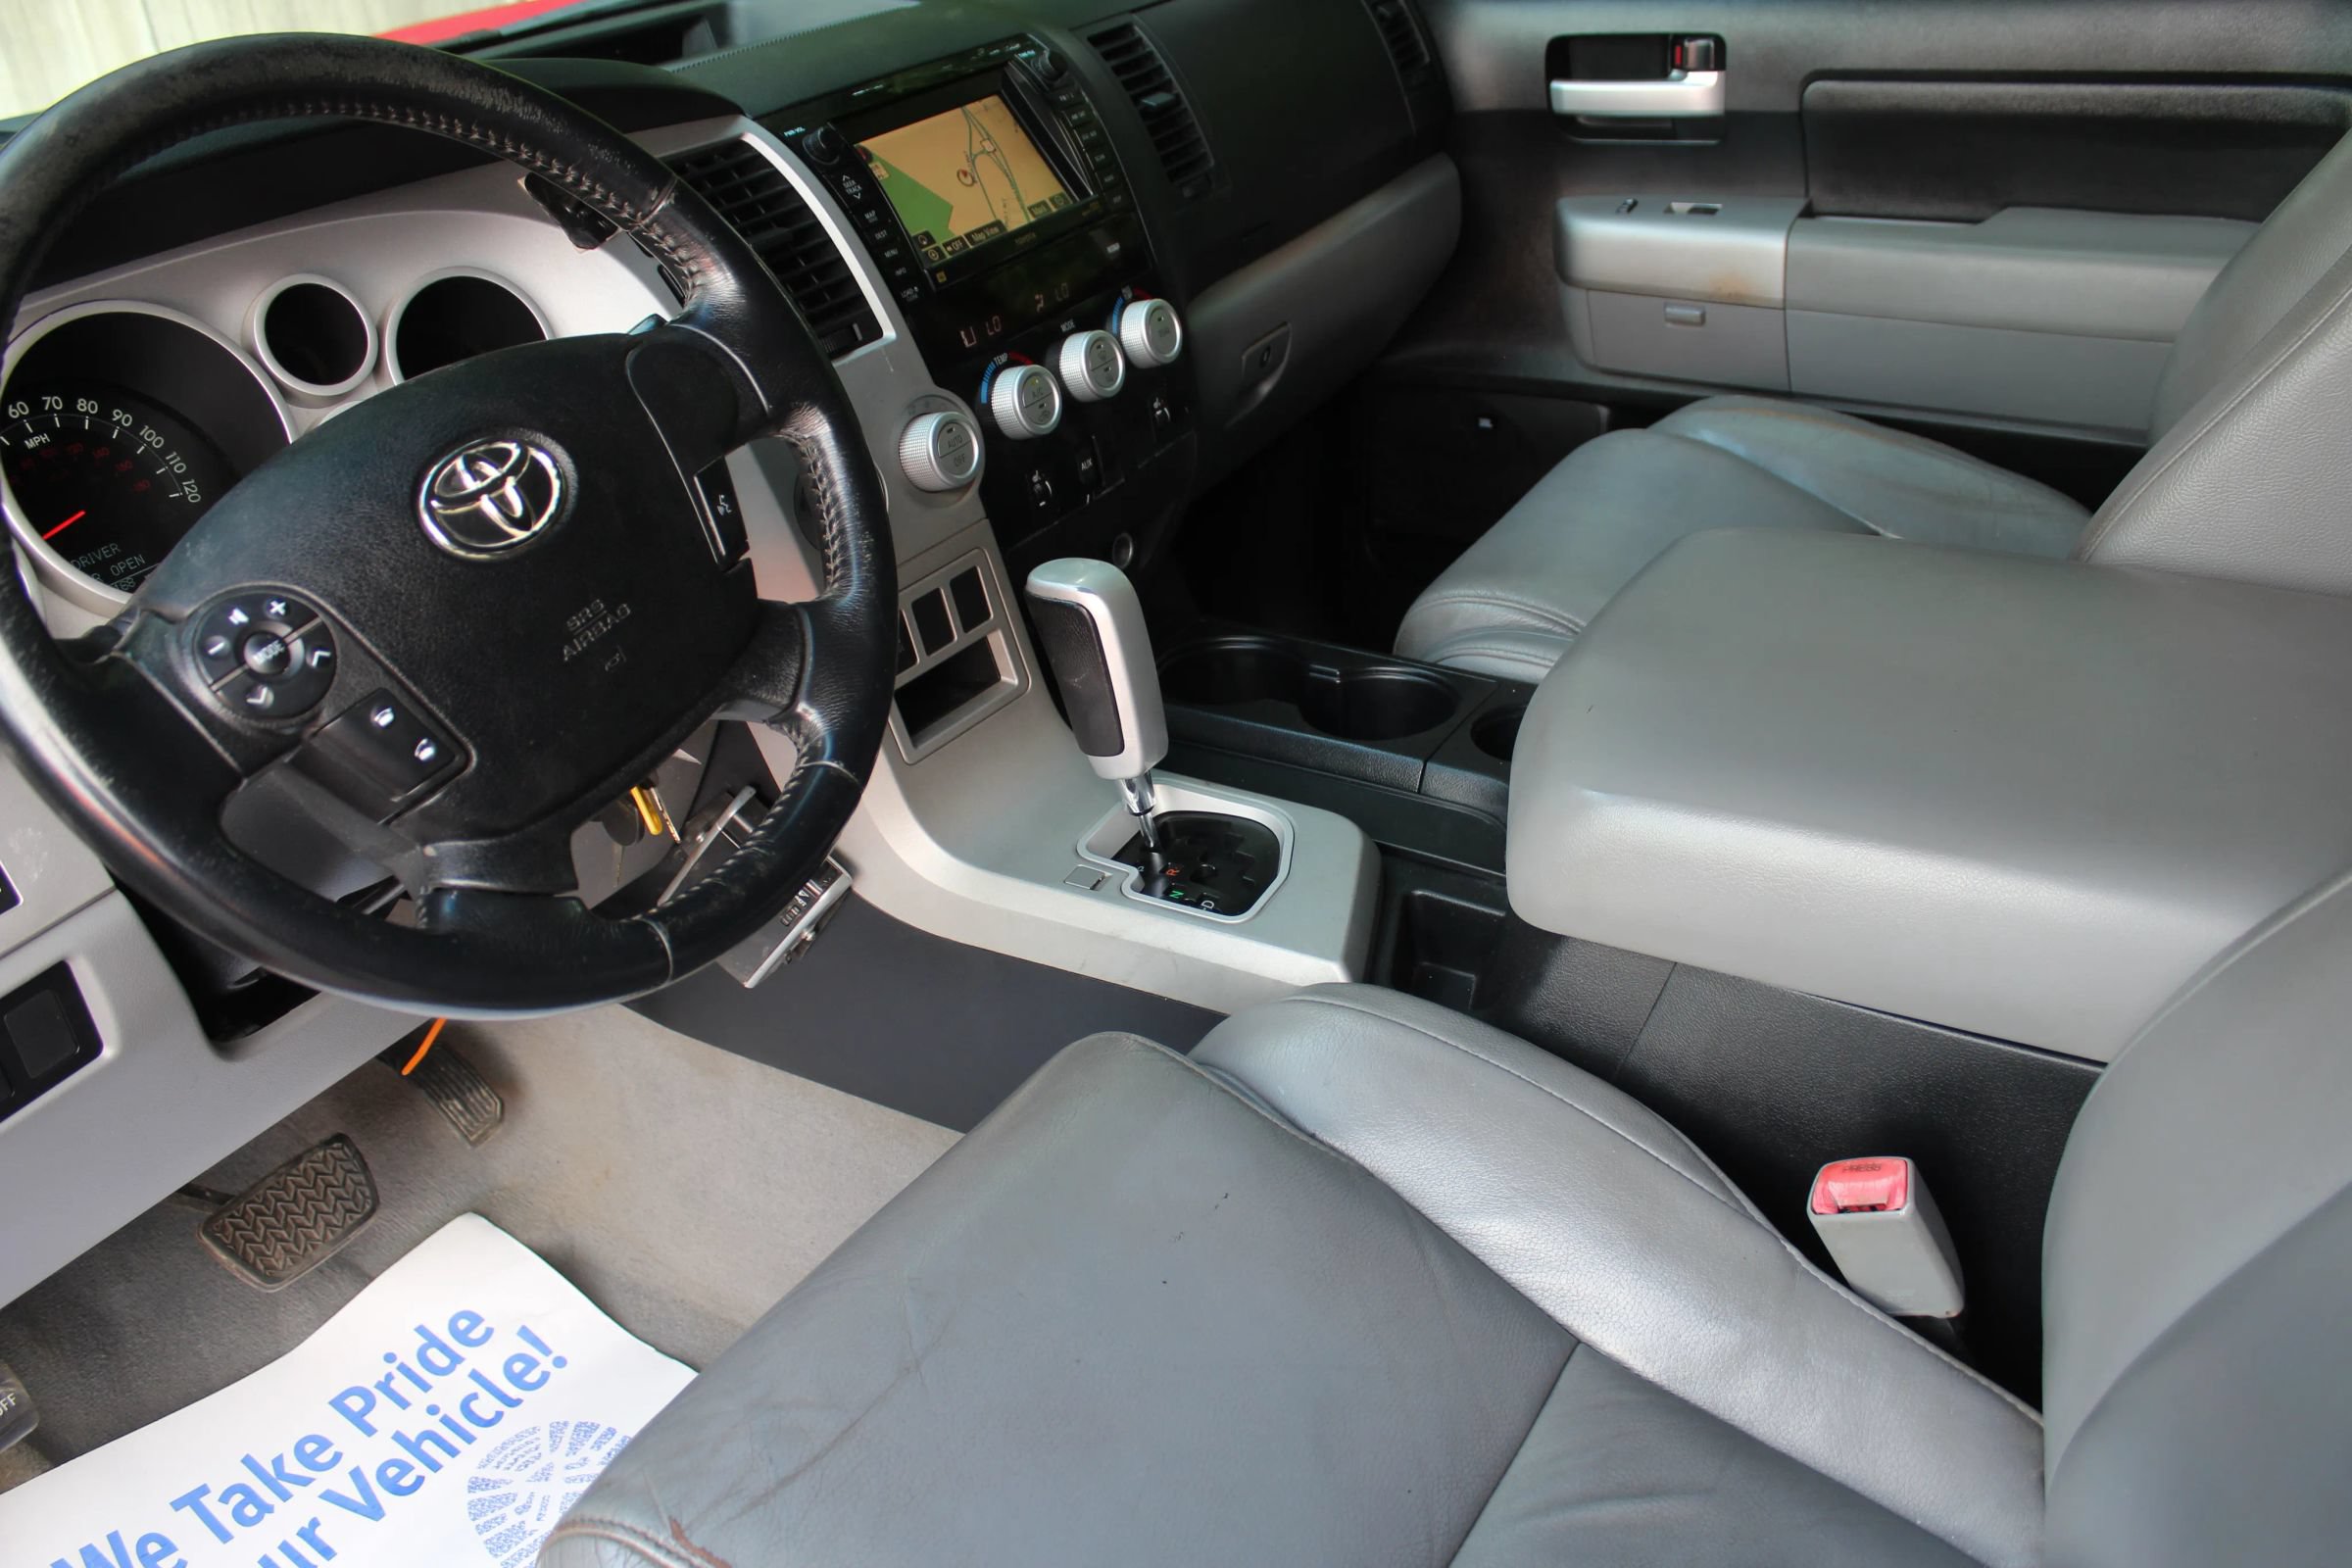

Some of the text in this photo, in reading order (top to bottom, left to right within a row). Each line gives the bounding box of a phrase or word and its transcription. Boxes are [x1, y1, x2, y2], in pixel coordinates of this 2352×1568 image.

[1059, 318, 1076, 333] MODE
[993, 352, 1009, 366] TEMP
[8, 401, 29, 418] 60
[42, 396, 64, 411] 70
[76, 398, 98, 415] 80
[112, 409, 133, 427] 90
[24, 432, 50, 450] MPH
[139, 424, 165, 449] 100
[948, 435, 963, 448] AUTO
[166, 451, 186, 474] 110
[1081, 458, 1093, 470] AUX
[182, 479, 201, 504] 120
[70, 543, 122, 570] DRIVER
[110, 554, 146, 576] OPEN
[566, 599, 605, 631] SRS
[563, 603, 631, 662] AIRBAG
[253, 639, 285, 664] MODE
[1165, 868, 1180, 877] R
[1169, 889, 1185, 900] N
[1200, 900, 1215, 909] D
[1842, 1162, 1882, 1173] PRESS
[170, 1434, 343, 1544] Take
[328, 1310, 494, 1438] Pride
[318, 1325, 568, 1522] Vehicle!
